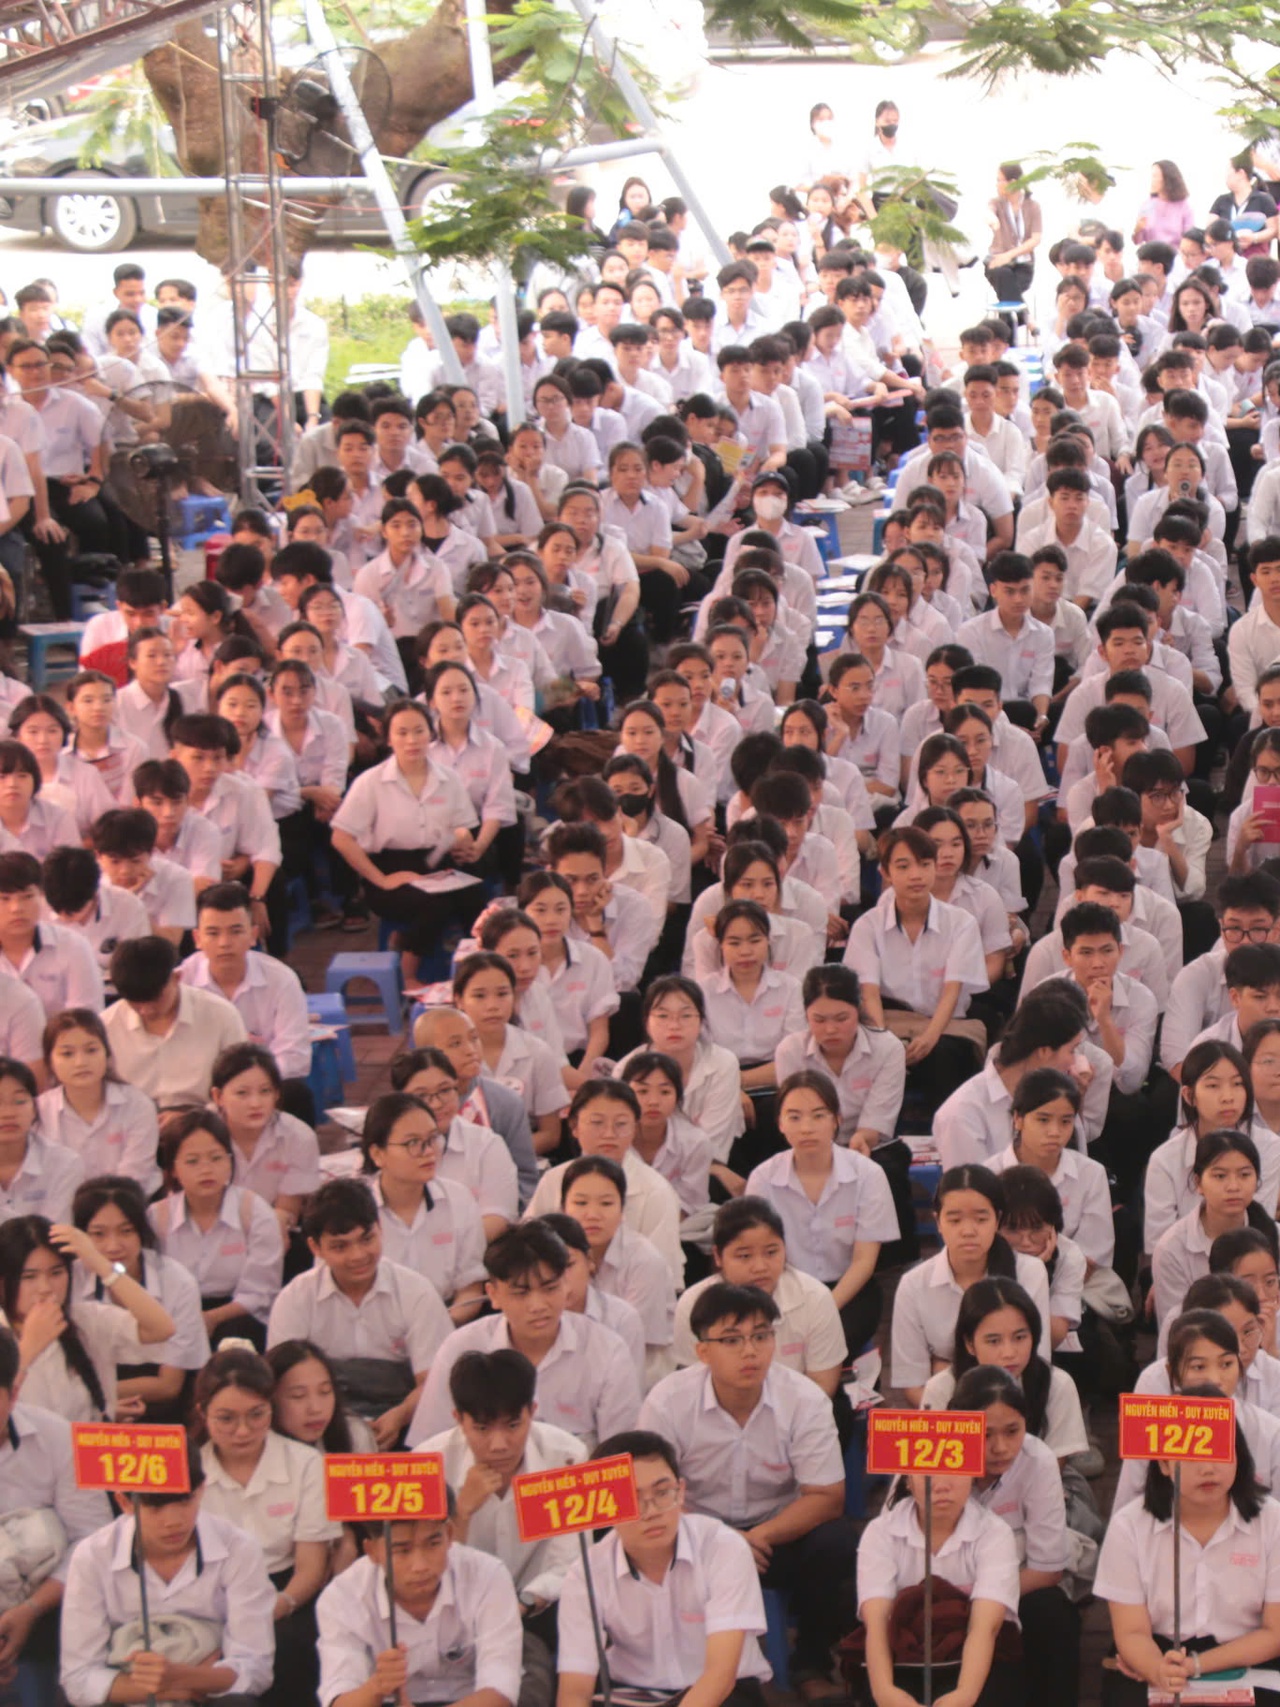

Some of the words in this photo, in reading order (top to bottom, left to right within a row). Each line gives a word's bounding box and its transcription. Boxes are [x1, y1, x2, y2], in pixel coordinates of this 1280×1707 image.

[1185, 1406, 1201, 1419] DUY
[895, 1437, 964, 1469] 12/3
[1145, 1423, 1213, 1455] 12/2
[98, 1453, 167, 1485] 12/6
[351, 1482, 424, 1513] 12/5
[543, 1488, 618, 1529] 12/4
